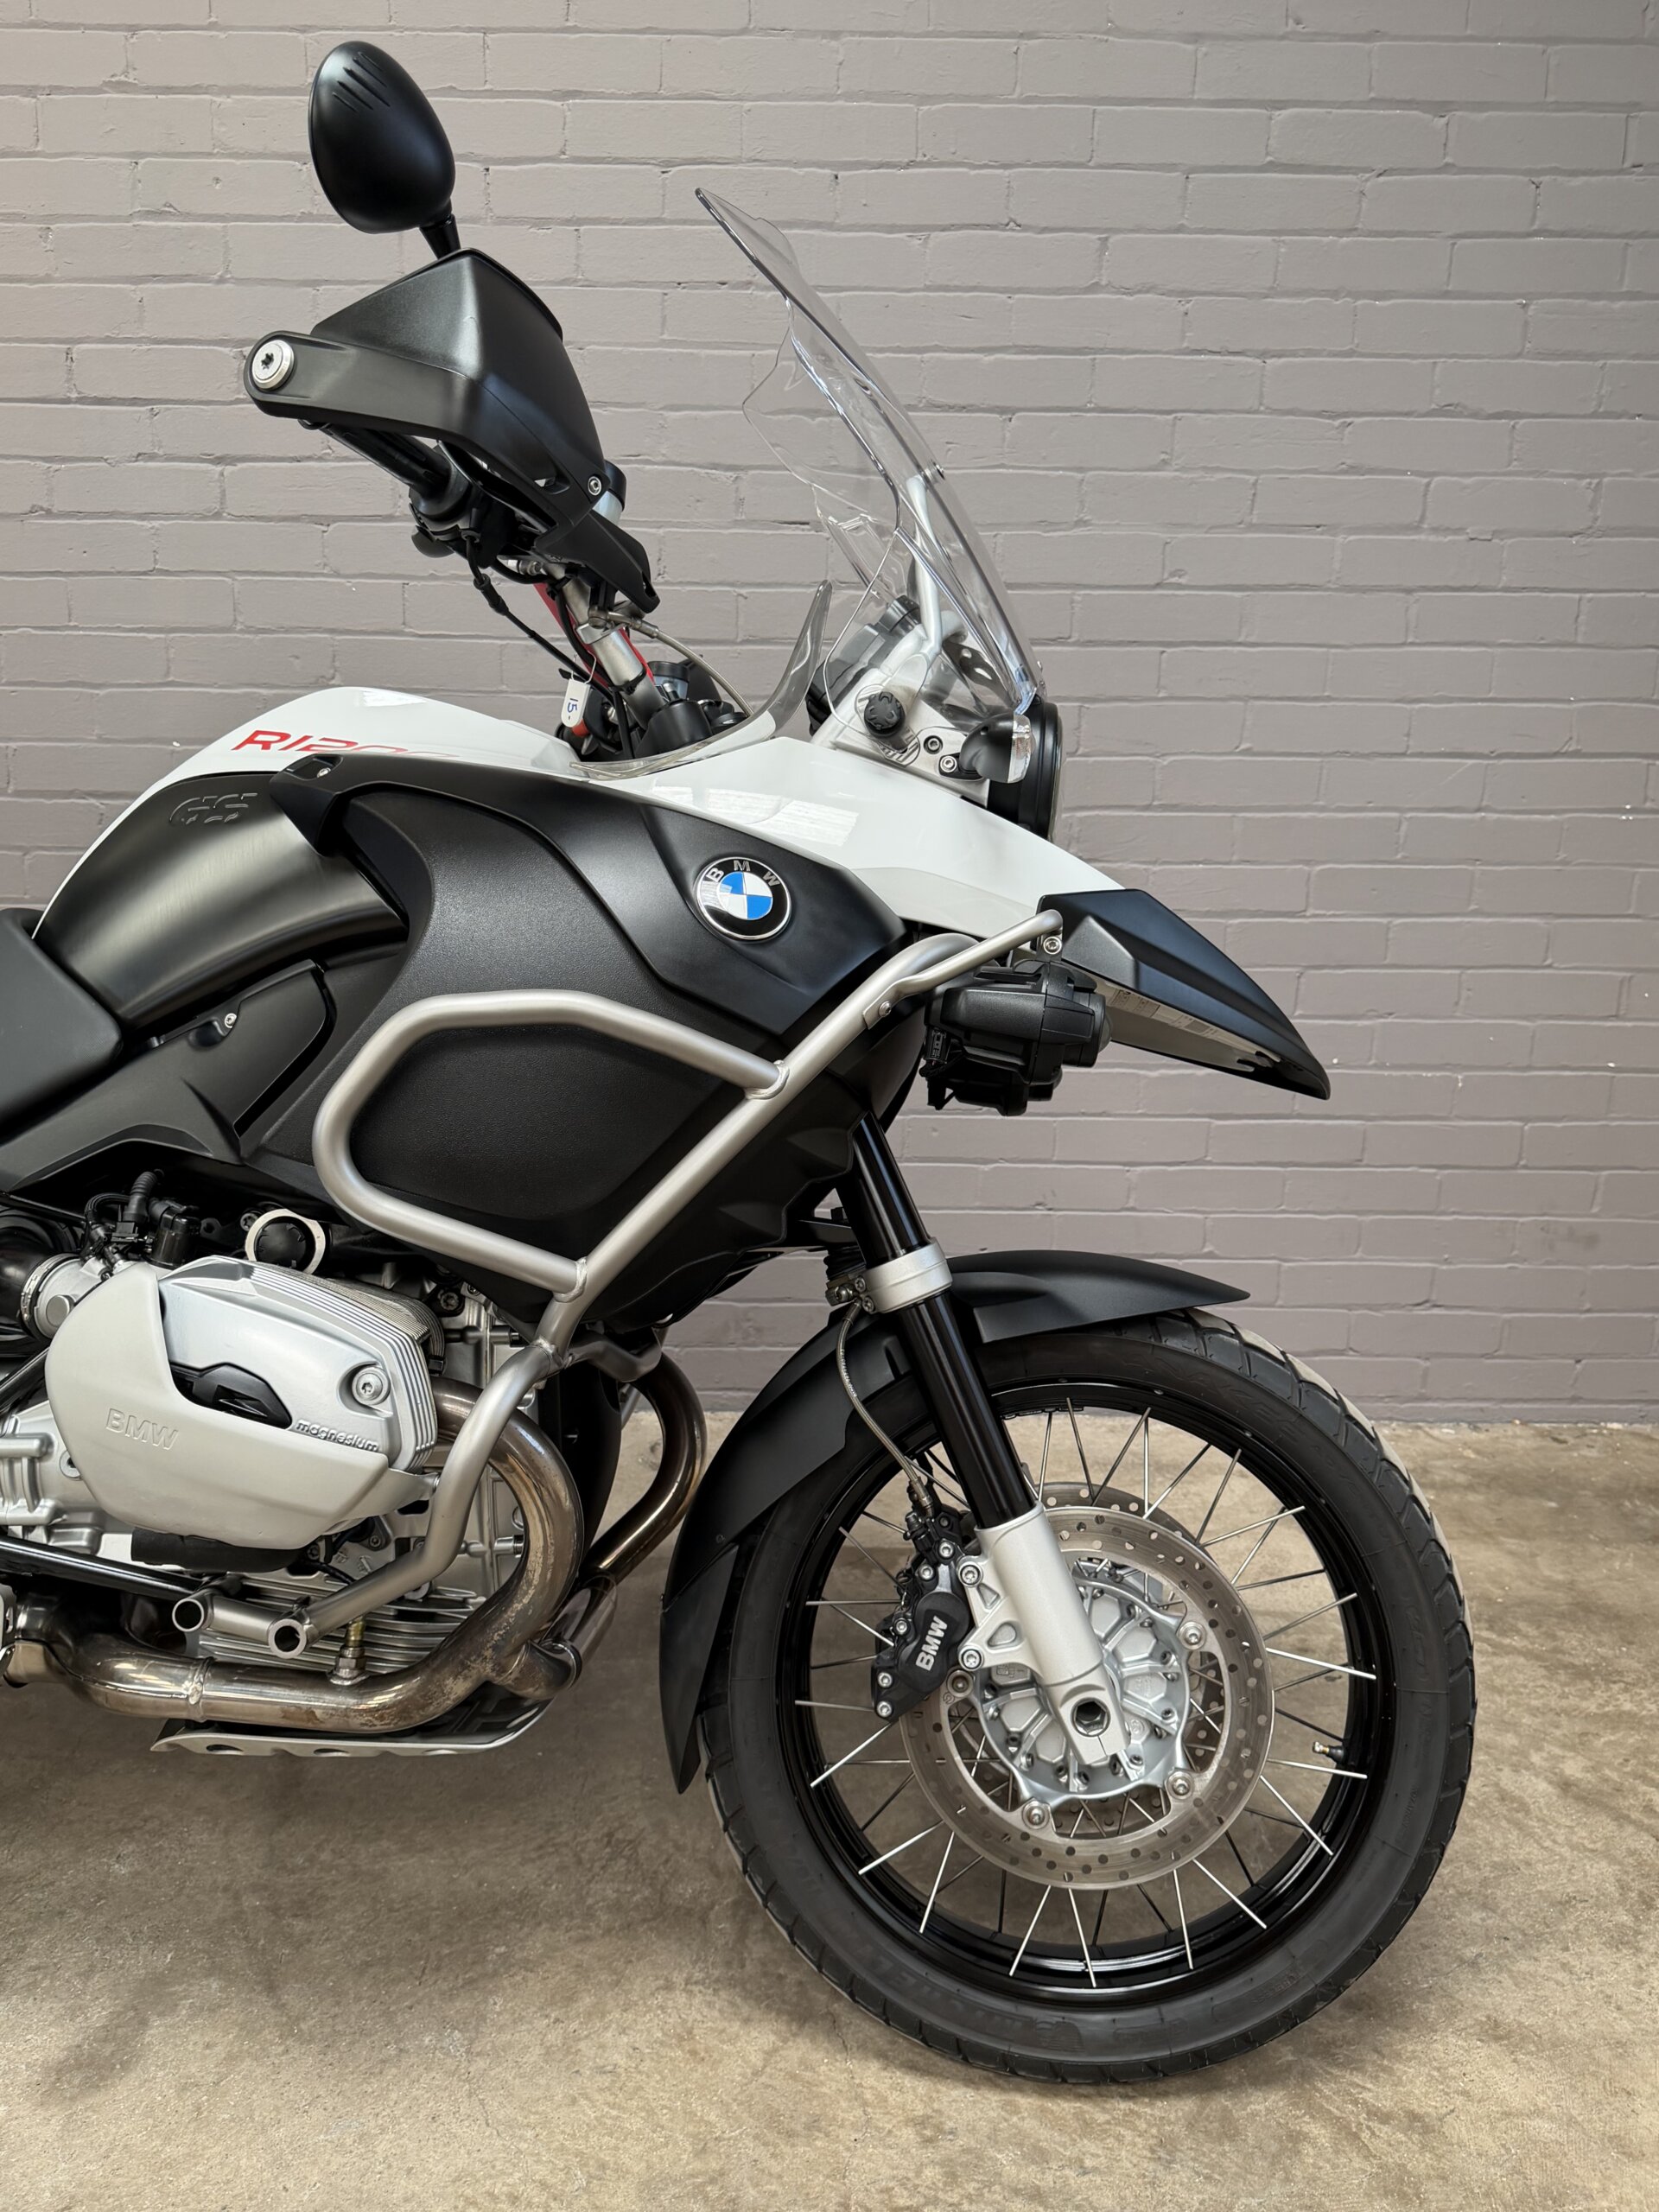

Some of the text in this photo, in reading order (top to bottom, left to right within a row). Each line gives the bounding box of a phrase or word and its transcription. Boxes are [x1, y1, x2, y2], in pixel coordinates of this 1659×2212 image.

[168, 792, 258, 825] GS
[705, 860, 781, 887] BMW
[105, 1408, 179, 1451] BMW
[296, 1418, 381, 1452] magnesium
[915, 1615, 948, 1671] BMW
